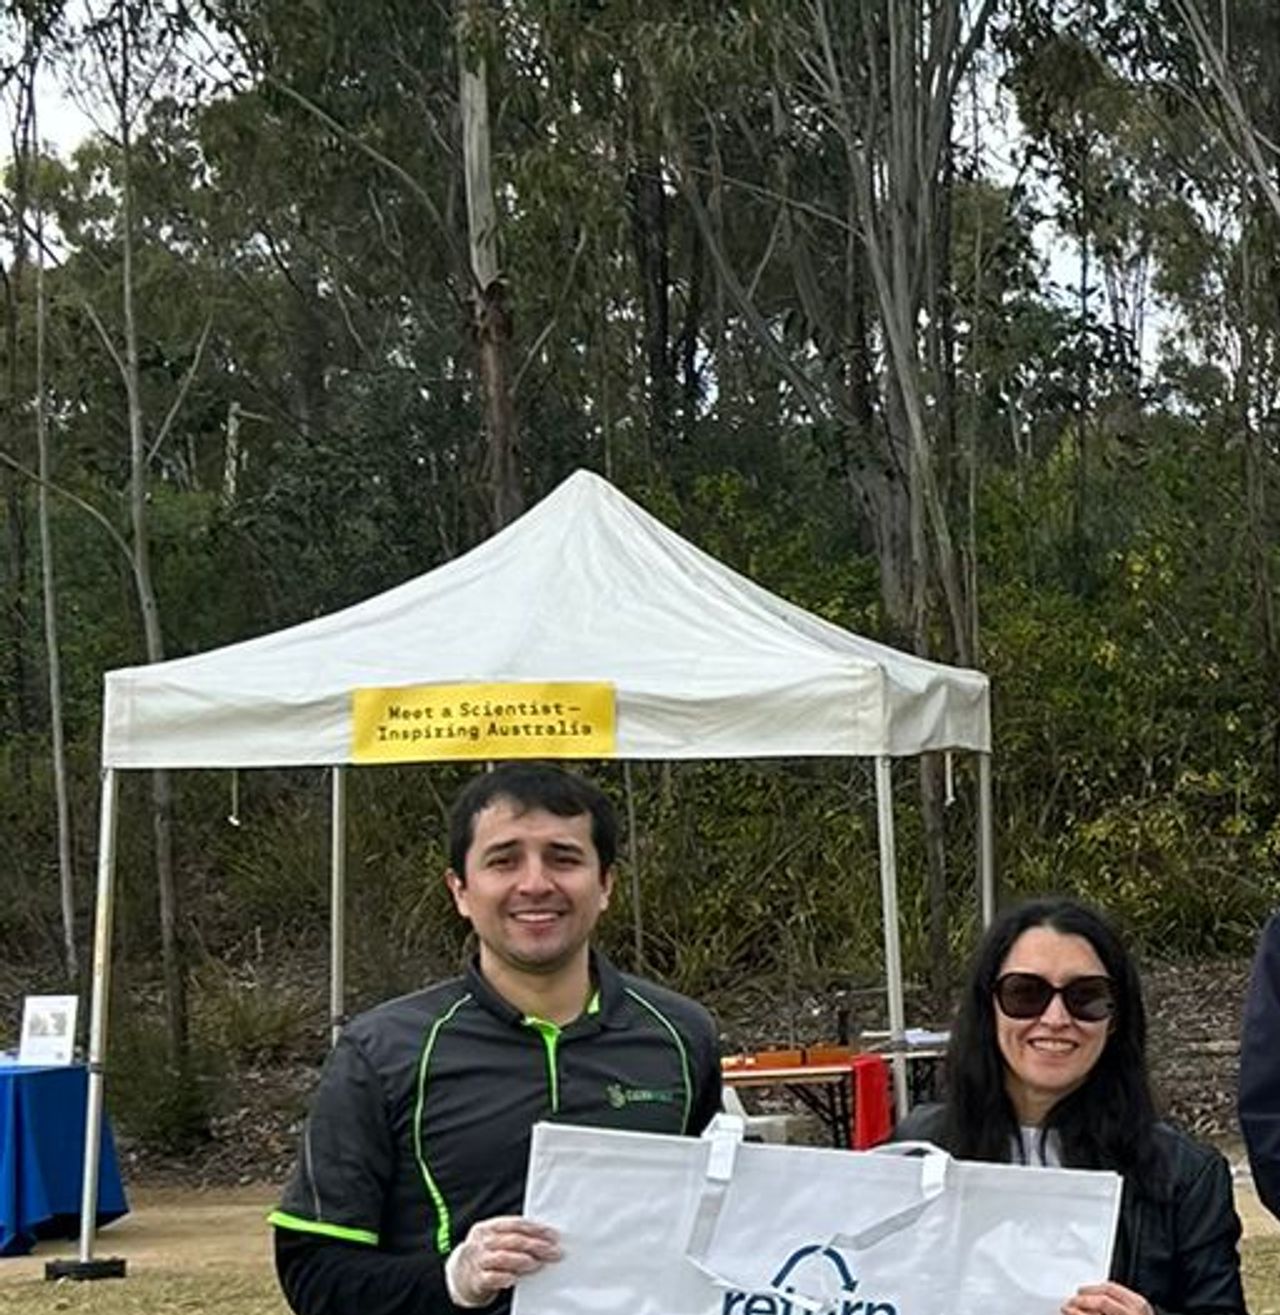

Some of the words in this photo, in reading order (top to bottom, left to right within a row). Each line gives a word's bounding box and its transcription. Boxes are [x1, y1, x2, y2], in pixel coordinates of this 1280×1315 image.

[388, 706, 433, 720] Meet
[442, 707, 452, 718] a
[459, 701, 563, 717] Scientist
[377, 726, 480, 742] Inspiring
[487, 721, 592, 737] Australia
